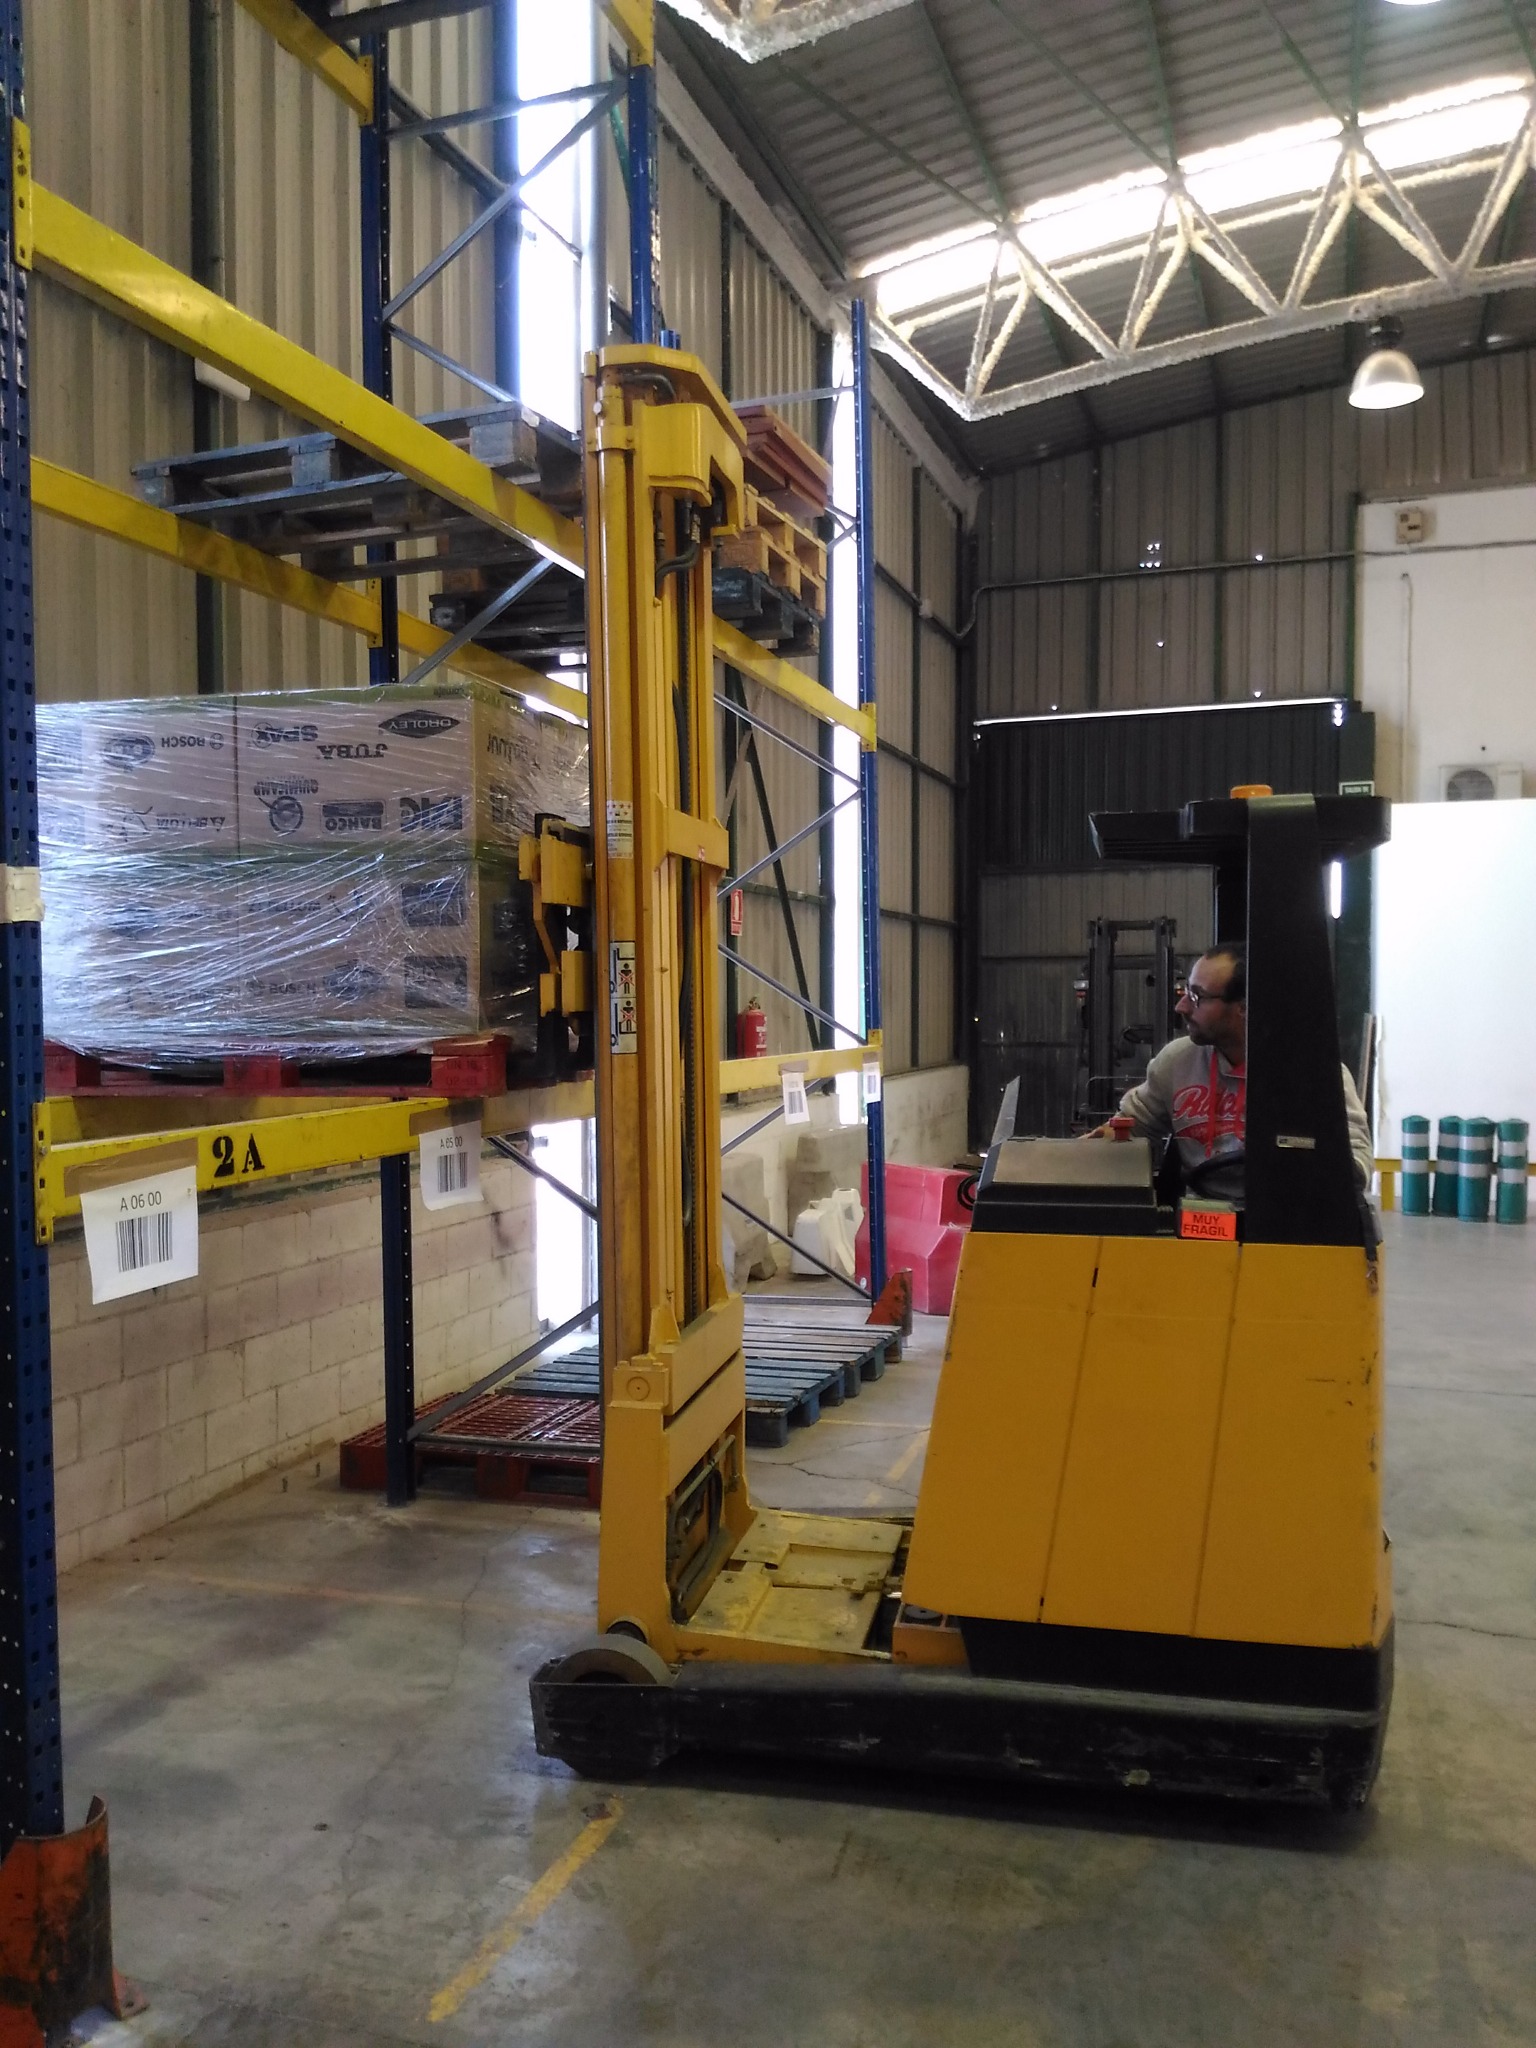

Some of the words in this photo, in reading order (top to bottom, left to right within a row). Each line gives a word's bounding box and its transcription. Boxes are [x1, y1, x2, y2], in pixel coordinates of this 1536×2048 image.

[161, 736, 206, 748] BOSCH
[317, 743, 388, 759] JUBA
[325, 816, 382, 831] BAHCO
[440, 1138, 445, 1149] A
[454, 1136, 463, 1148] 00
[212, 1133, 265, 1178] 2A
[120, 1198, 128, 1212] A
[130, 1194, 145, 1210] 06
[148, 1190, 162, 1207] 00
[1193, 1213, 1220, 1225] MUY
[1183, 1224, 1228, 1237] FRAGIL
